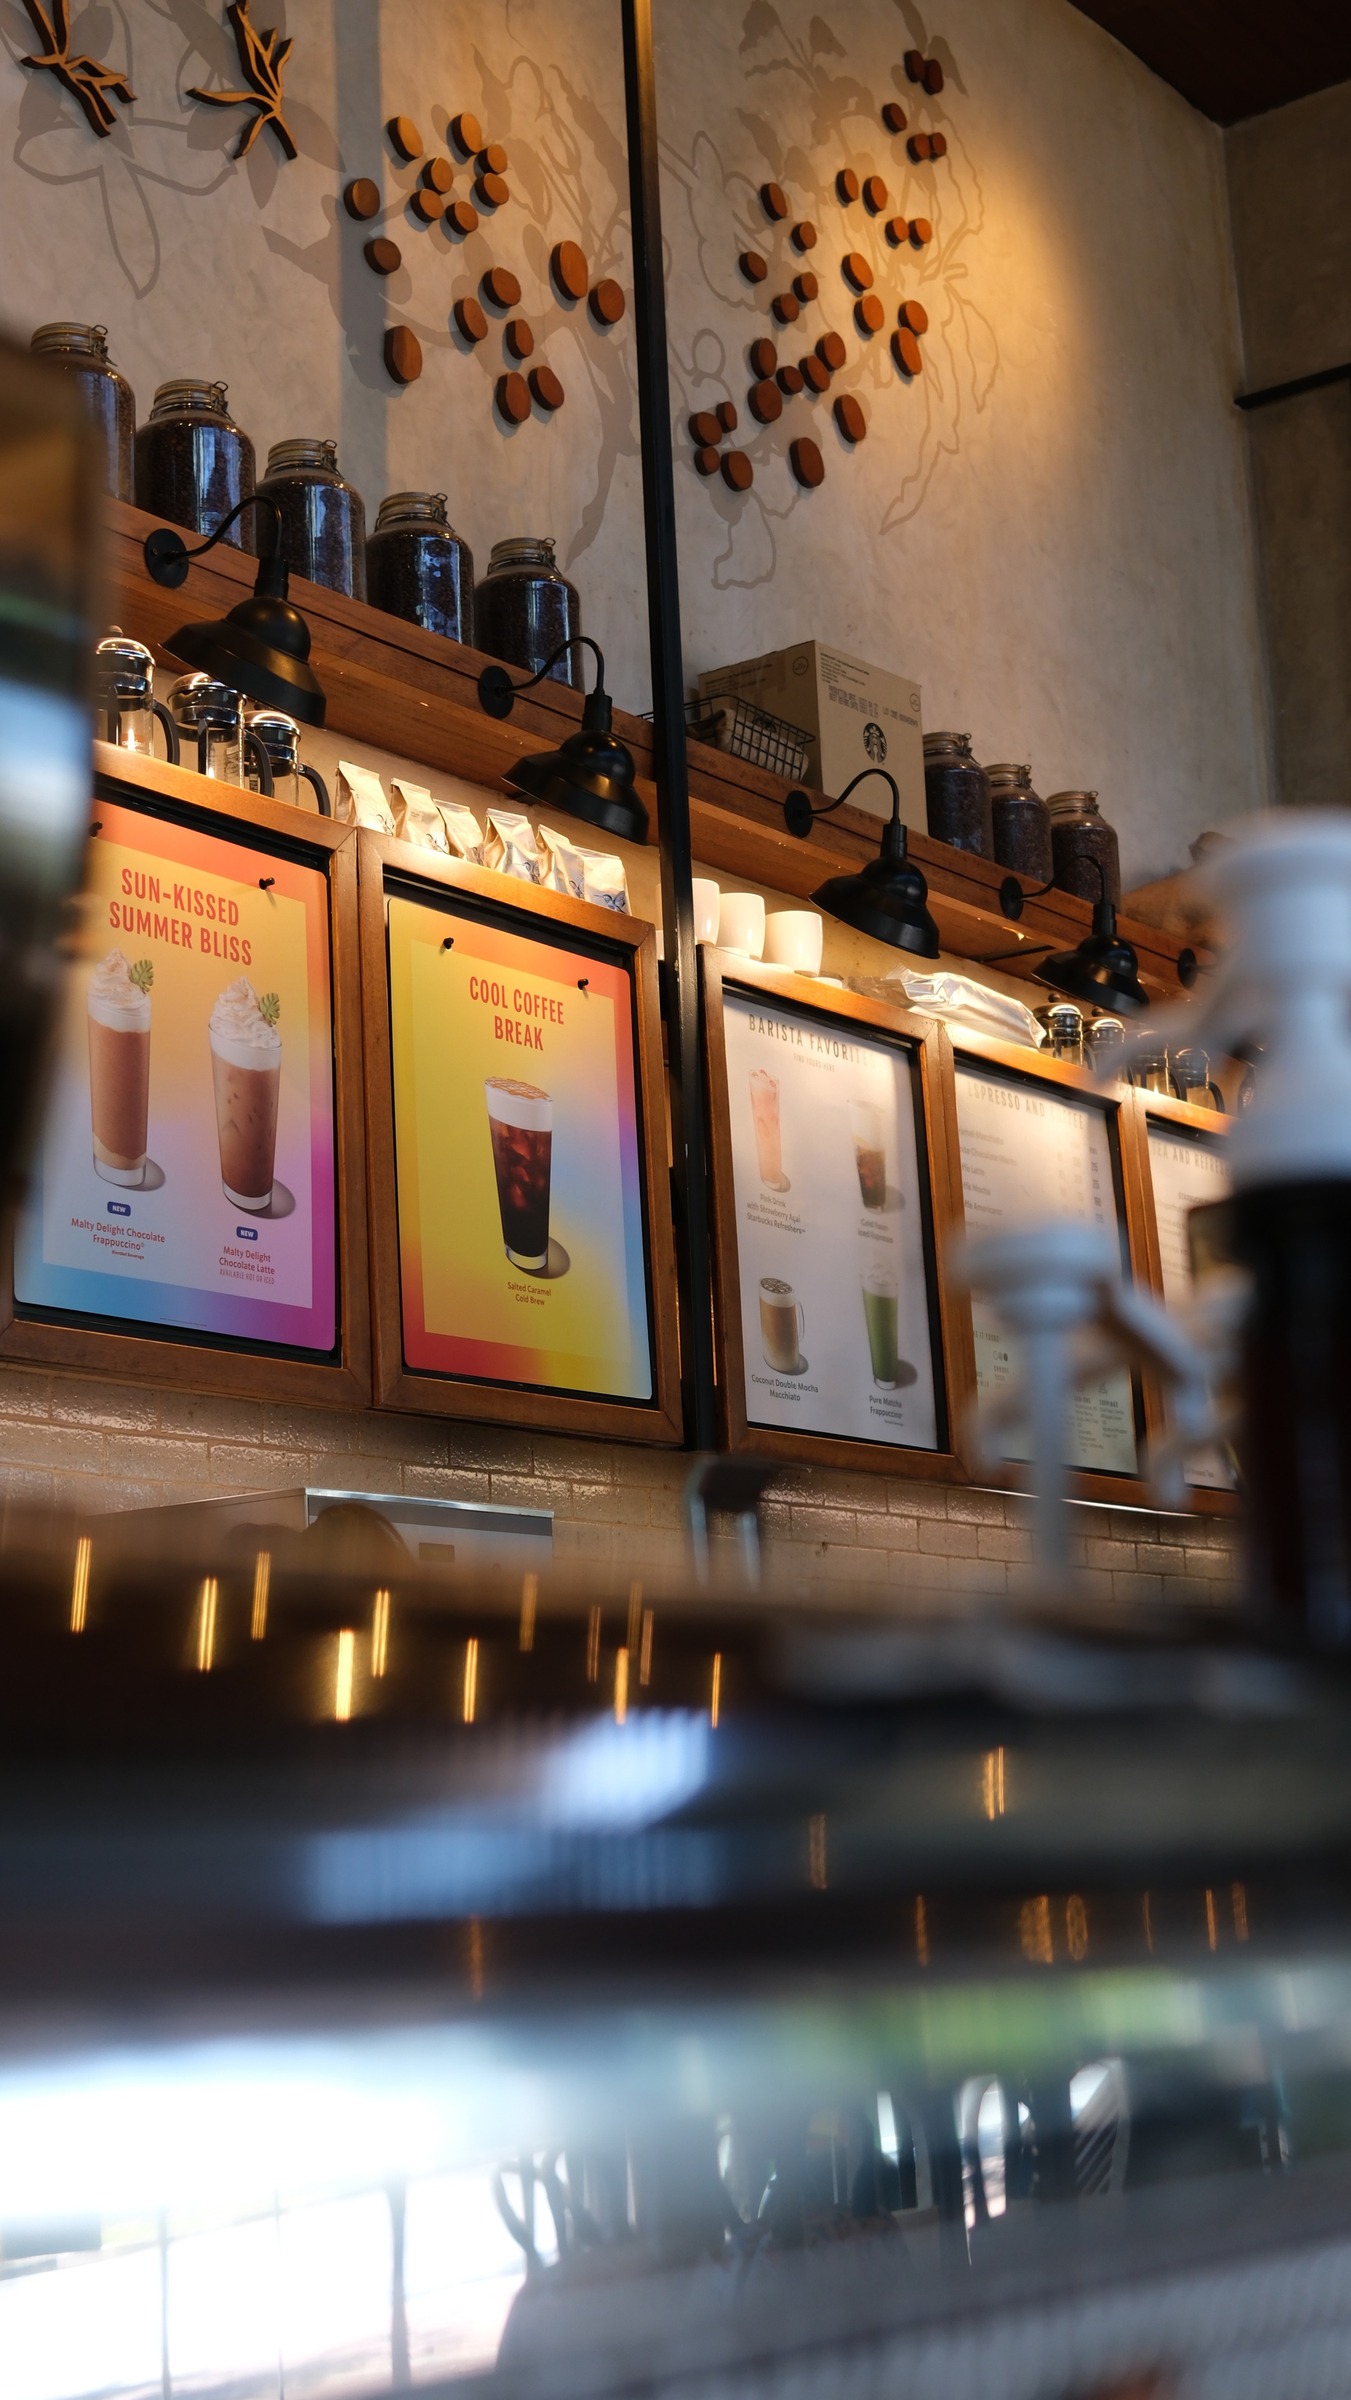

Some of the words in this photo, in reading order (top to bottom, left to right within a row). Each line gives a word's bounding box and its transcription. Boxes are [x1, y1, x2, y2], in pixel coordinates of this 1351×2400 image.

[122, 868, 239, 926] SUN-KISSED
[109, 901, 192, 949] SUMMER
[200, 927, 252, 966] BLISS
[470, 976, 508, 1009] COOL
[513, 988, 564, 1025] COFFEE
[494, 1015, 544, 1051] BREAK
[749, 1014, 804, 1047] BARISTA
[967, 1081, 1020, 1111] ESPRESSO
[1026, 1098, 1045, 1117] AND
[1173, 1147, 1190, 1165] AND
[1194, 1152, 1230, 1176] REFRES
[112, 1205, 126, 1213] NEW
[759, 1204, 788, 1222] Strawberry
[746, 1212, 774, 1228] Starbucks
[71, 1217, 95, 1232] Malty
[96, 1222, 125, 1237] Delight
[126, 1227, 166, 1243] Chocolate
[240, 1230, 254, 1238] NEW
[223, 1246, 244, 1259] Malty
[245, 1250, 271, 1263] Delight
[219, 1256, 256, 1272] Chocolate
[256, 1264, 276, 1275] Latte
[219, 1268, 245, 1280] AVAILABLE
[246, 1273, 255, 1281] HOT
[256, 1275, 263, 1283] OR
[263, 1276, 275, 1285] ICED
[507, 1281, 527, 1292] Salted
[527, 1285, 552, 1297] Caramel
[515, 1293, 529, 1303] Cold
[530, 1296, 545, 1306] Brew
[751, 1374, 775, 1387] Coconut
[775, 1378, 797, 1391] Double
[797, 1382, 819, 1394] Mocha
[769, 1389, 801, 1402] Macchiato
[869, 1394, 882, 1405] Pure
[883, 1397, 903, 1409] Matcha
